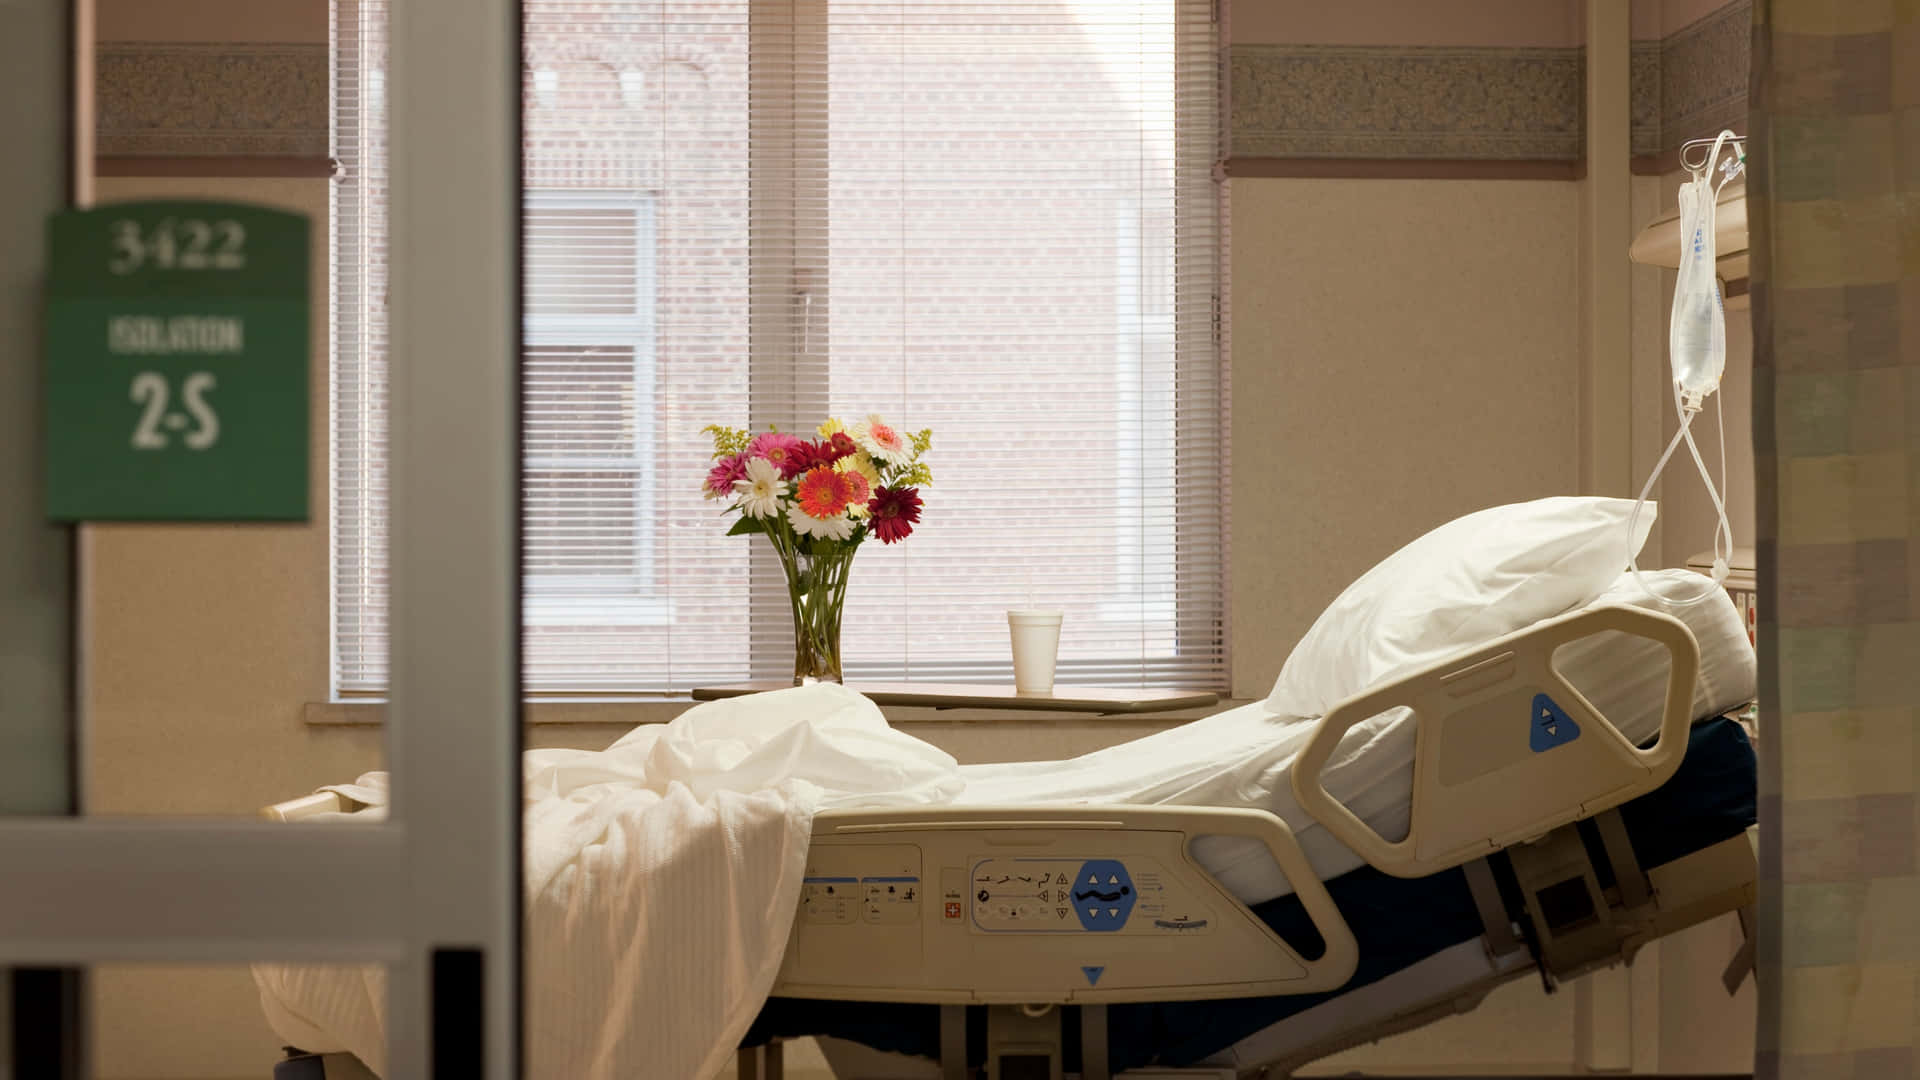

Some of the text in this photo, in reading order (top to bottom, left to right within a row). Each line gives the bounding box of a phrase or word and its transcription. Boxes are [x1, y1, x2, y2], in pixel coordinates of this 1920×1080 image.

[109, 218, 246, 275] 3422
[108, 316, 244, 353] ISOLATION
[130, 372, 219, 448] 2-S
